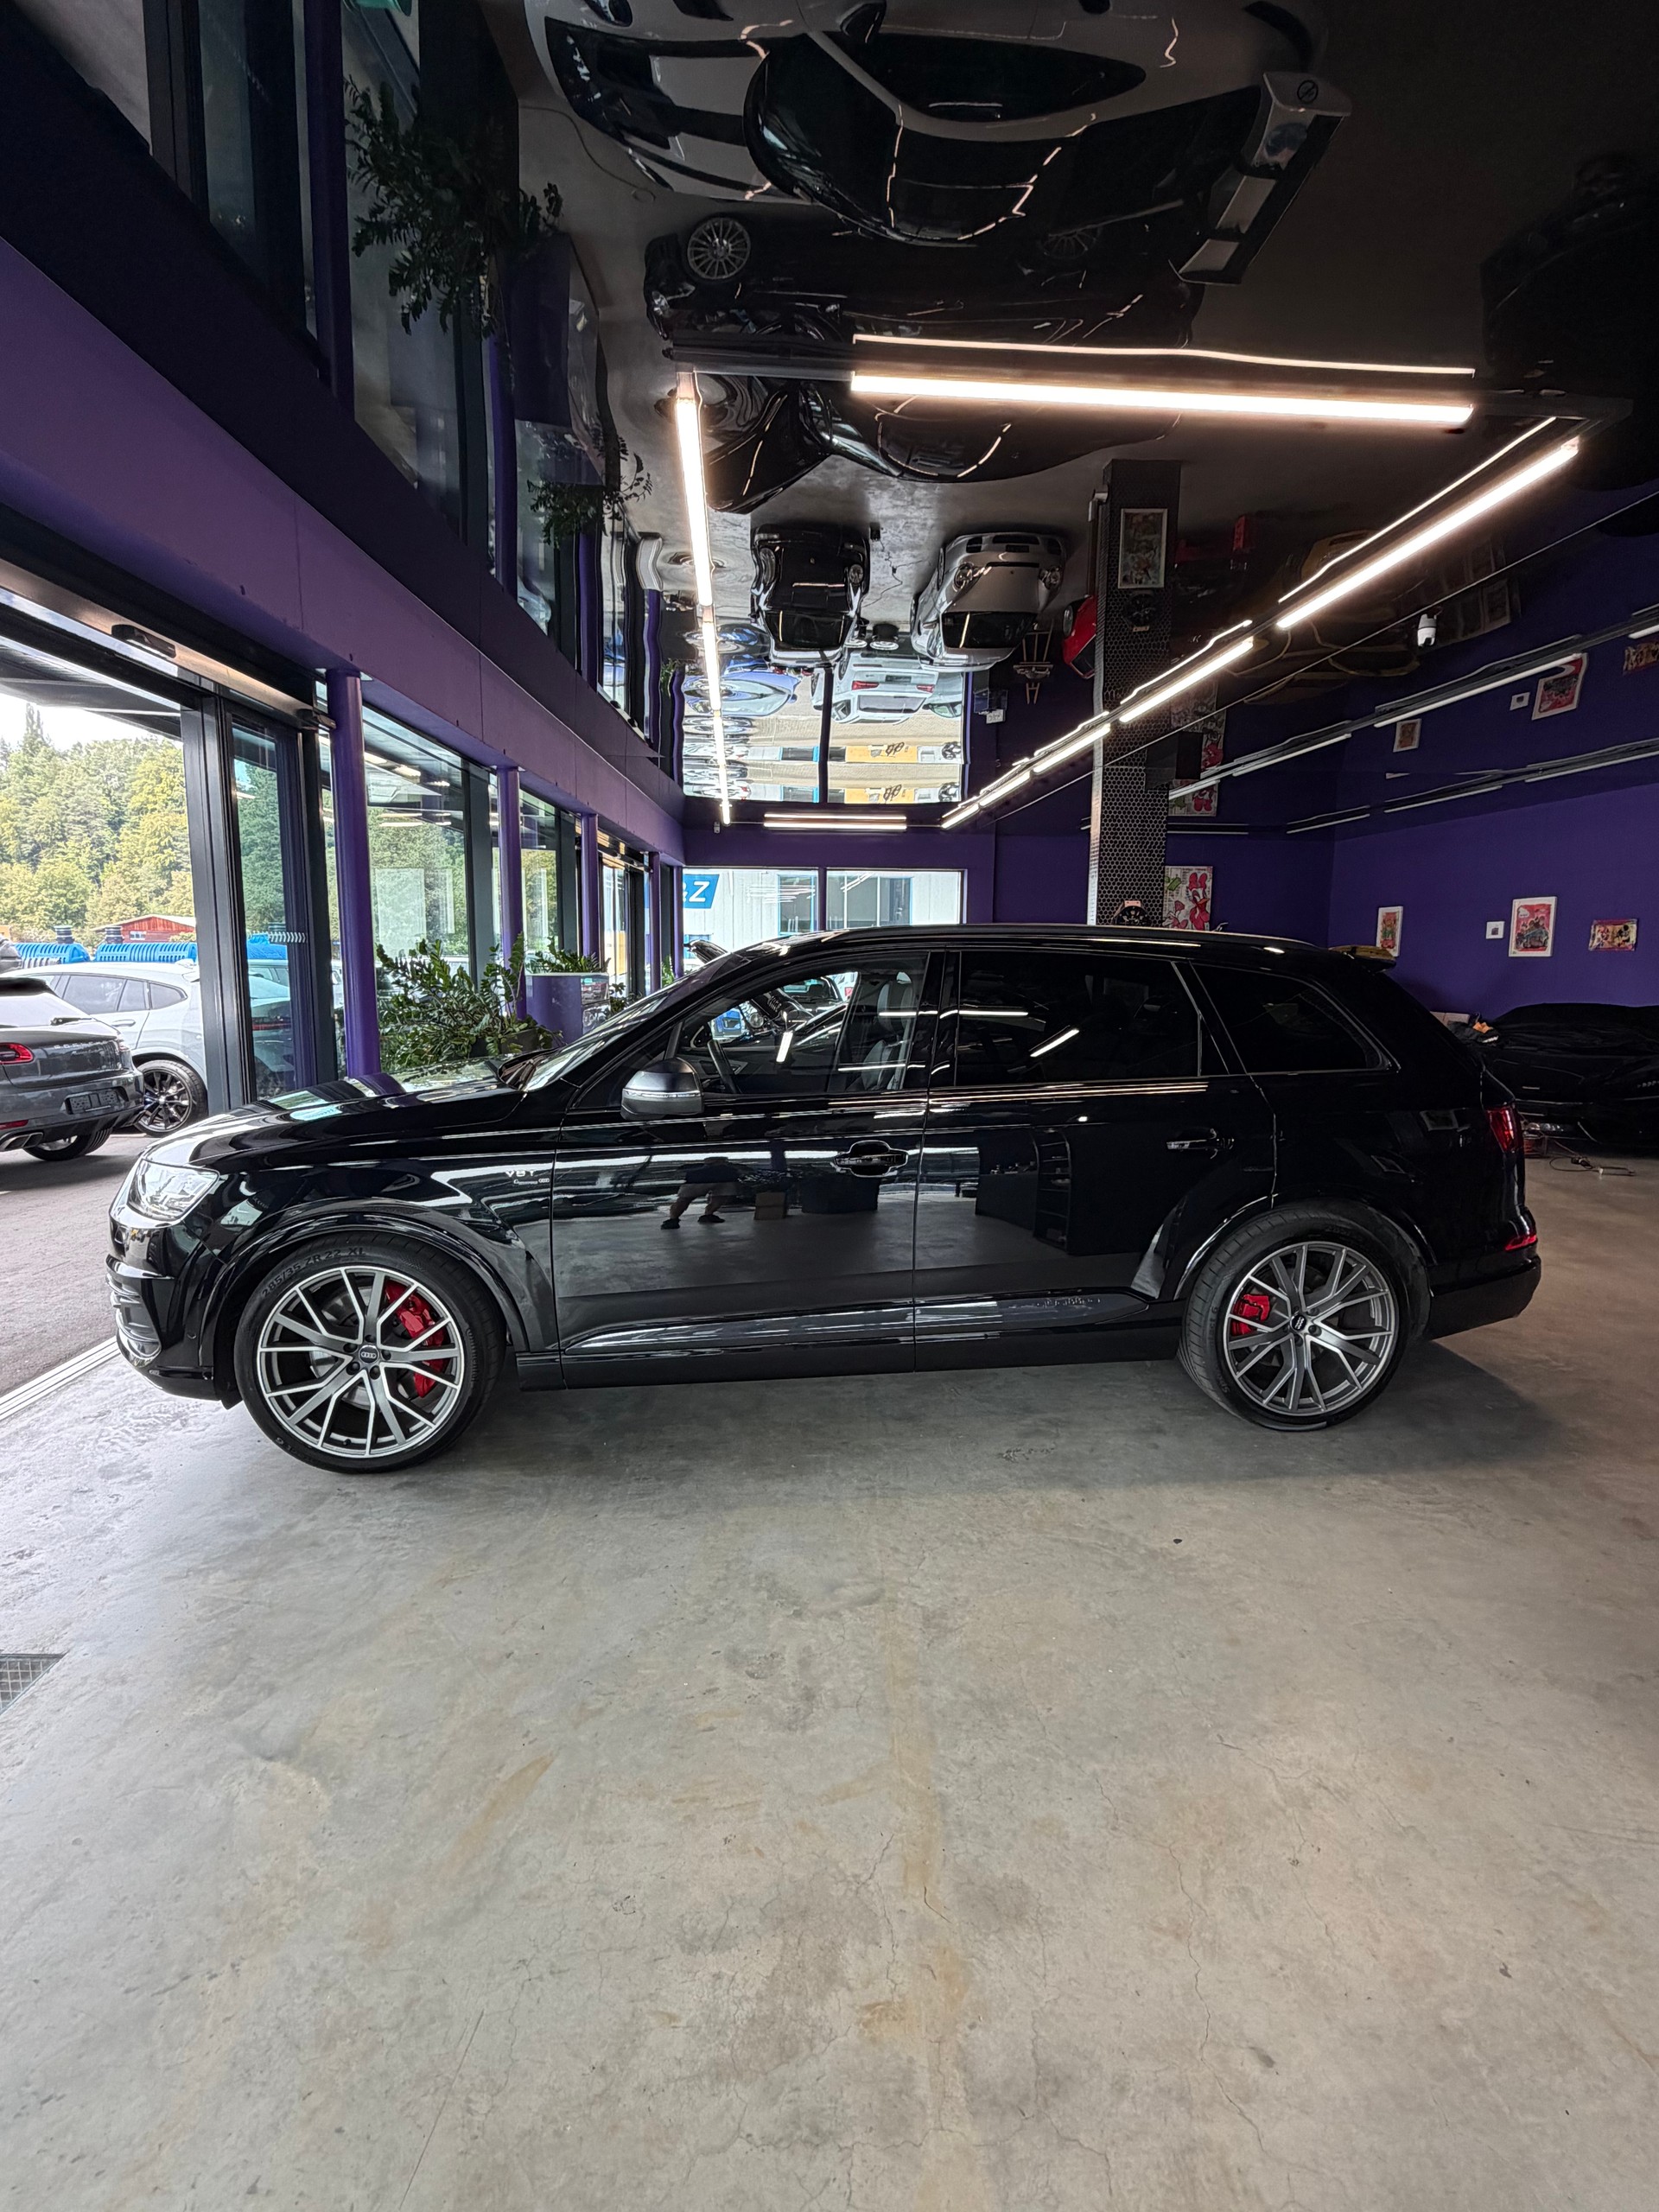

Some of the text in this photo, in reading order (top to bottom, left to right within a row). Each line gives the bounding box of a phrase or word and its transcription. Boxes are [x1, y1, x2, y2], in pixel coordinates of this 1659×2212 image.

[683, 881, 710, 903] Z
[262, 1247, 366, 1296] 285/35 ZR 22 XL
